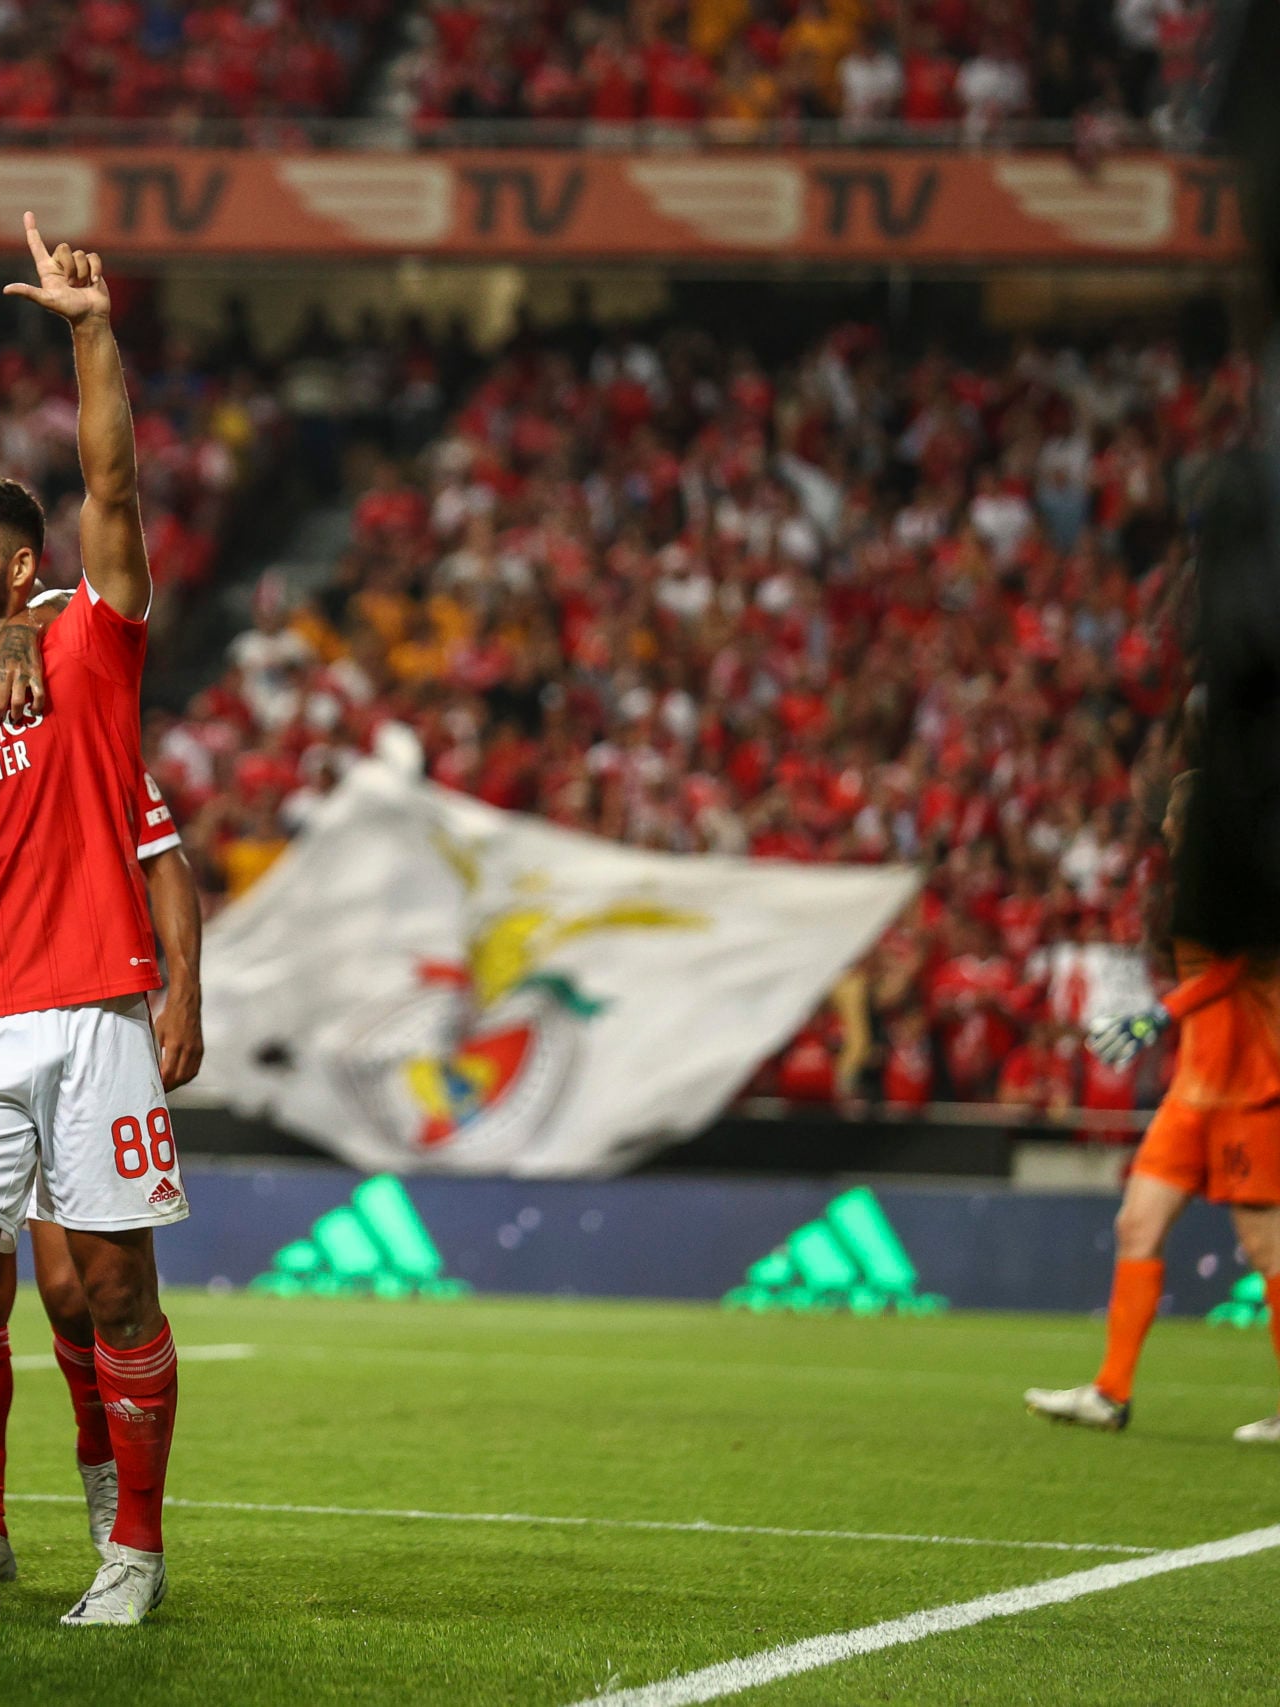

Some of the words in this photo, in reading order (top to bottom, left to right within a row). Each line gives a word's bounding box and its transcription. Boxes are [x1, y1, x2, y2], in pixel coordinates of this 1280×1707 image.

[107, 165, 228, 233] TV
[463, 166, 585, 235] TV
[812, 168, 939, 238] TV
[111, 1107, 175, 1180] 88
[148, 1188, 181, 1204] adidas
